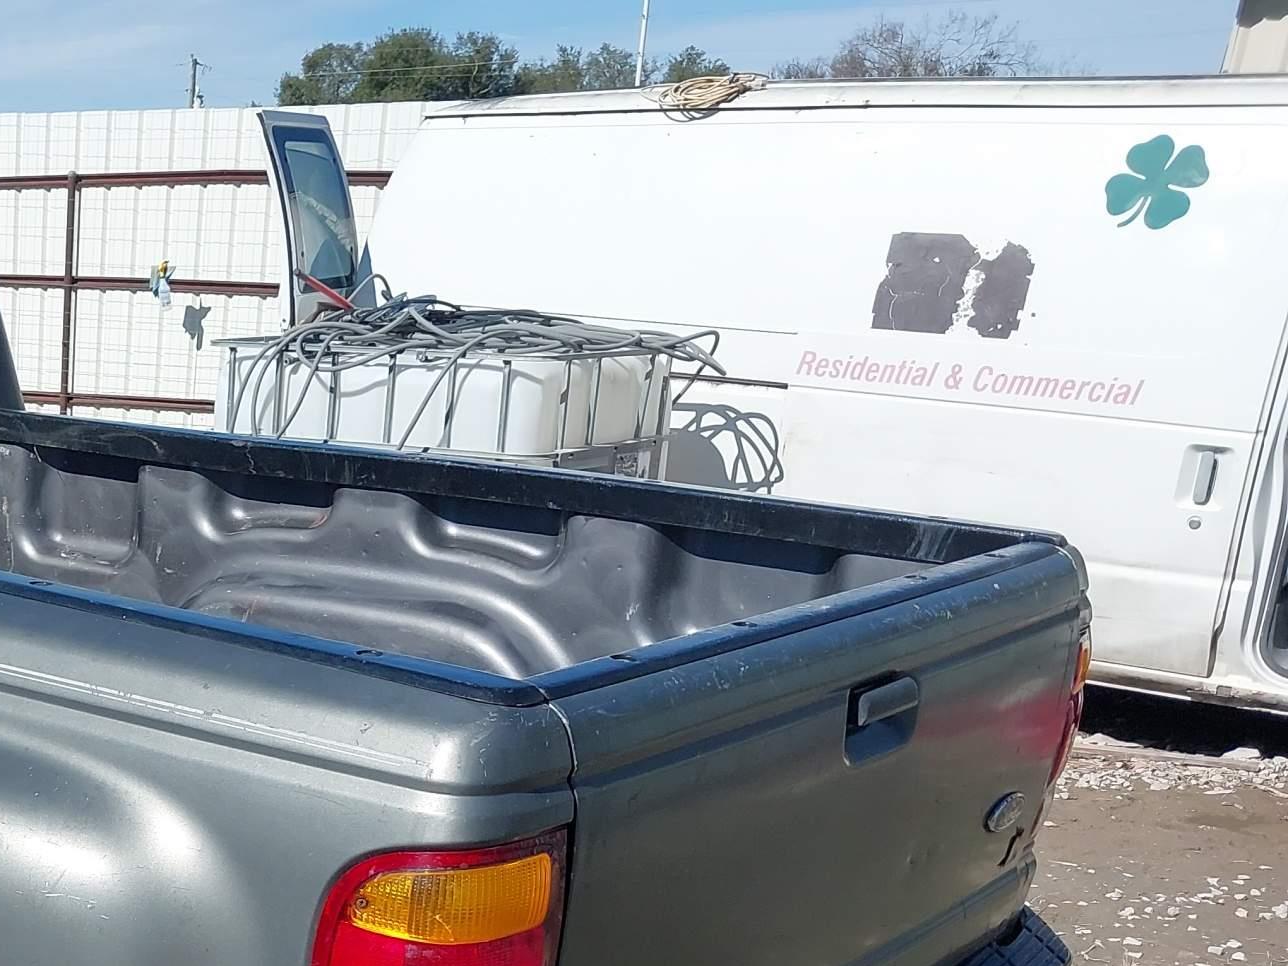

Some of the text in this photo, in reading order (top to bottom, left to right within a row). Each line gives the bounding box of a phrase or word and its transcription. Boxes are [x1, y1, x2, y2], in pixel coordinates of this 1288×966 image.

[796, 350, 1145, 406] Residential & Commercial
